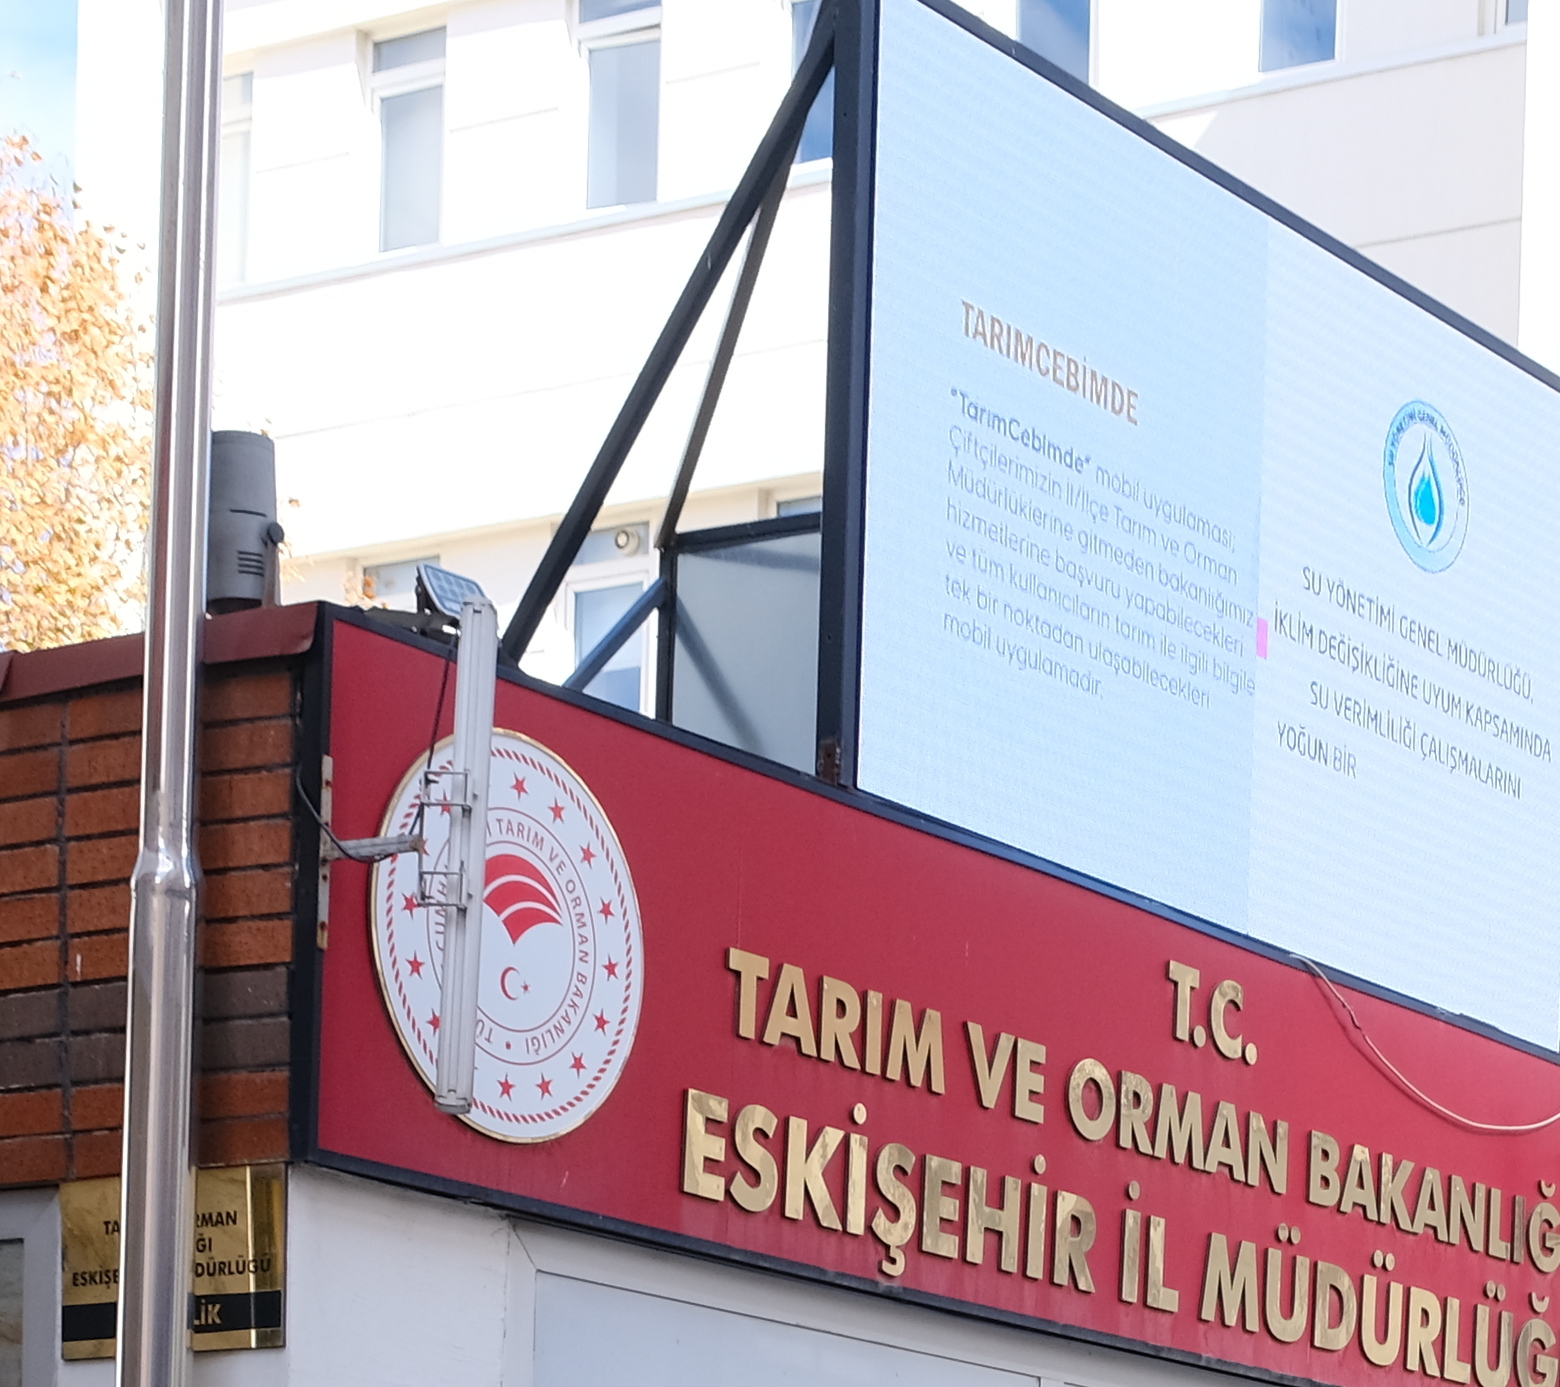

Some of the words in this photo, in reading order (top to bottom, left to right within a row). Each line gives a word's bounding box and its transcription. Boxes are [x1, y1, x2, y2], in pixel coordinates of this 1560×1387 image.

[962, 299, 1139, 426] TARIMCEBİMDE
[946, 540, 966, 565] ve
[972, 548, 1004, 582] tüm
[1116, 615, 1155, 650] tarım
[947, 496, 1050, 567] hizmetlerine
[1055, 549, 1120, 600] başvuru
[1126, 587, 1243, 657] yapabilecekleri
[1078, 529, 1154, 582] gitmeden
[1158, 563, 1253, 628] bakanlığımız
[1114, 505, 1156, 548] Tarım
[1161, 533, 1179, 557] ve
[1184, 542, 1237, 586] Orman
[943, 613, 991, 650] mobil
[945, 574, 970, 605] tek
[977, 585, 998, 615] bir
[1003, 603, 1083, 654] noktadan
[1089, 641, 1210, 709] ulaşabilecekleri
[1302, 566, 1322, 596] SU
[1326, 577, 1395, 635] YÖNETİMİ
[1400, 615, 1443, 658] GENEL
[1274, 600, 1314, 650] İKLİM
[1318, 629, 1418, 700] DEĞİŞİKLİĞİNE
[1422, 680, 1462, 721] UYUM
[1465, 701, 1552, 763] KAPSAMINDA
[1277, 721, 1328, 767] YOĞUN
[1333, 745, 1357, 780] BİR
[1310, 681, 1329, 710] SU
[1334, 691, 1416, 752] VERİMLİLİĞİ
[1421, 732, 1521, 800] ÇALIŞMALARINI
[496, 818, 545, 850] TARIM
[548, 847, 567, 875] VE
[566, 879, 589, 964] ORMAN
[525, 973, 588, 1056] BAKANLIĞI
[1167, 959, 1258, 1066] T.C.
[727, 947, 945, 1095] TARIM
[963, 1020, 1045, 1124] VE
[1067, 1057, 1288, 1195] ORMAN
[682, 1087, 1095, 1294] ESKİŞEHİR
[1121, 1179, 1179, 1313] İL
